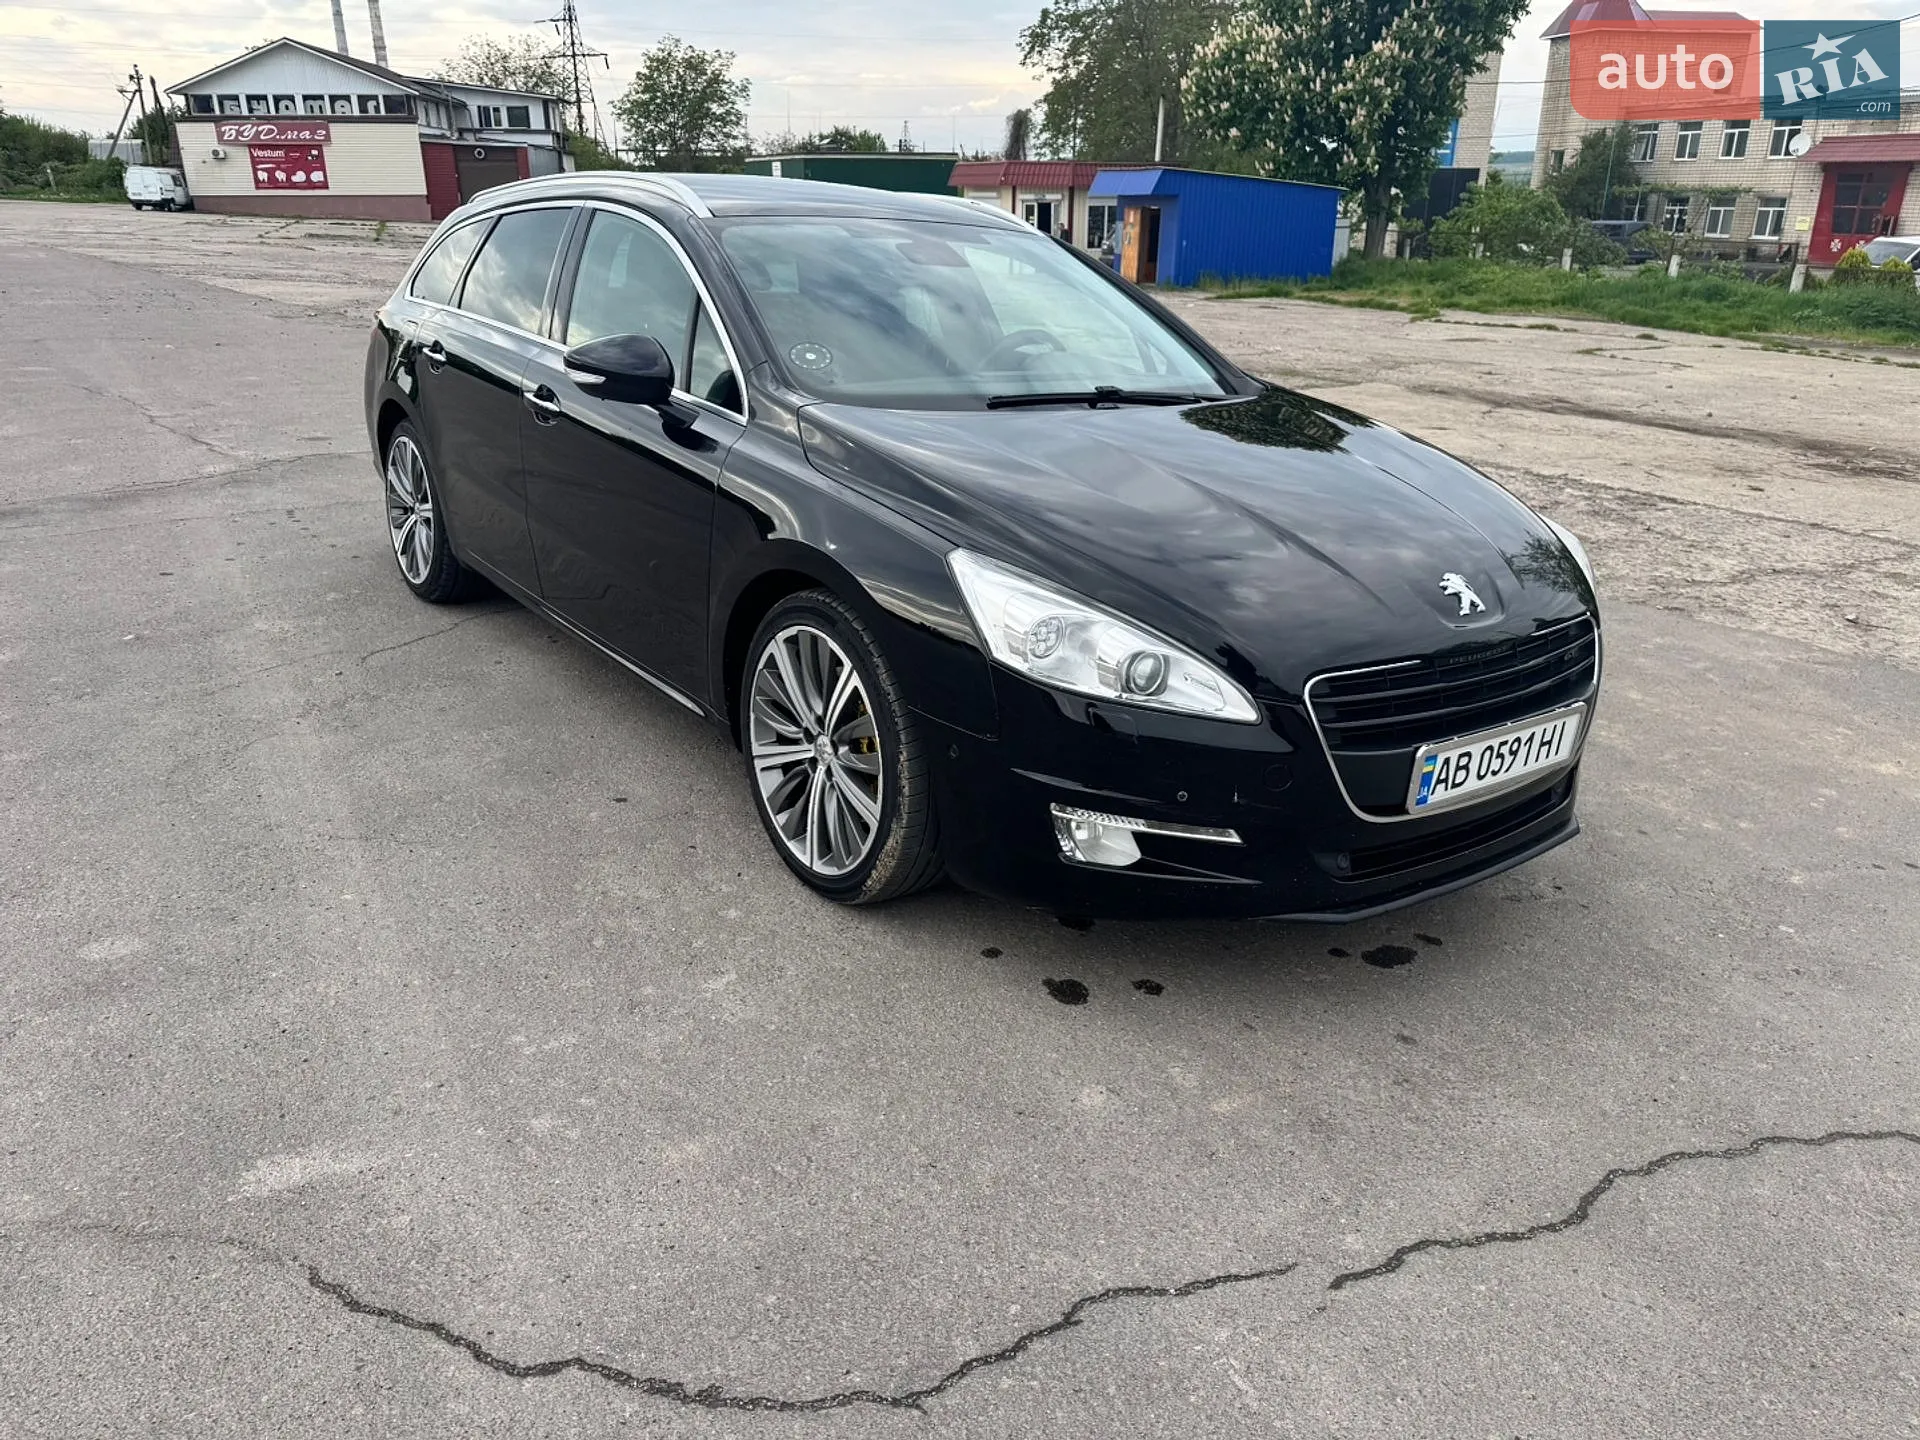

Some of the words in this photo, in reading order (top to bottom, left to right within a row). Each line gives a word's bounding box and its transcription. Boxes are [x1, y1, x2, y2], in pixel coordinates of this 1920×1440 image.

[250, 147, 285, 158] Vestum
[1430, 750, 1473, 796] AB
[1476, 731, 1536, 781] 0591
[1534, 721, 1566, 763] HI
